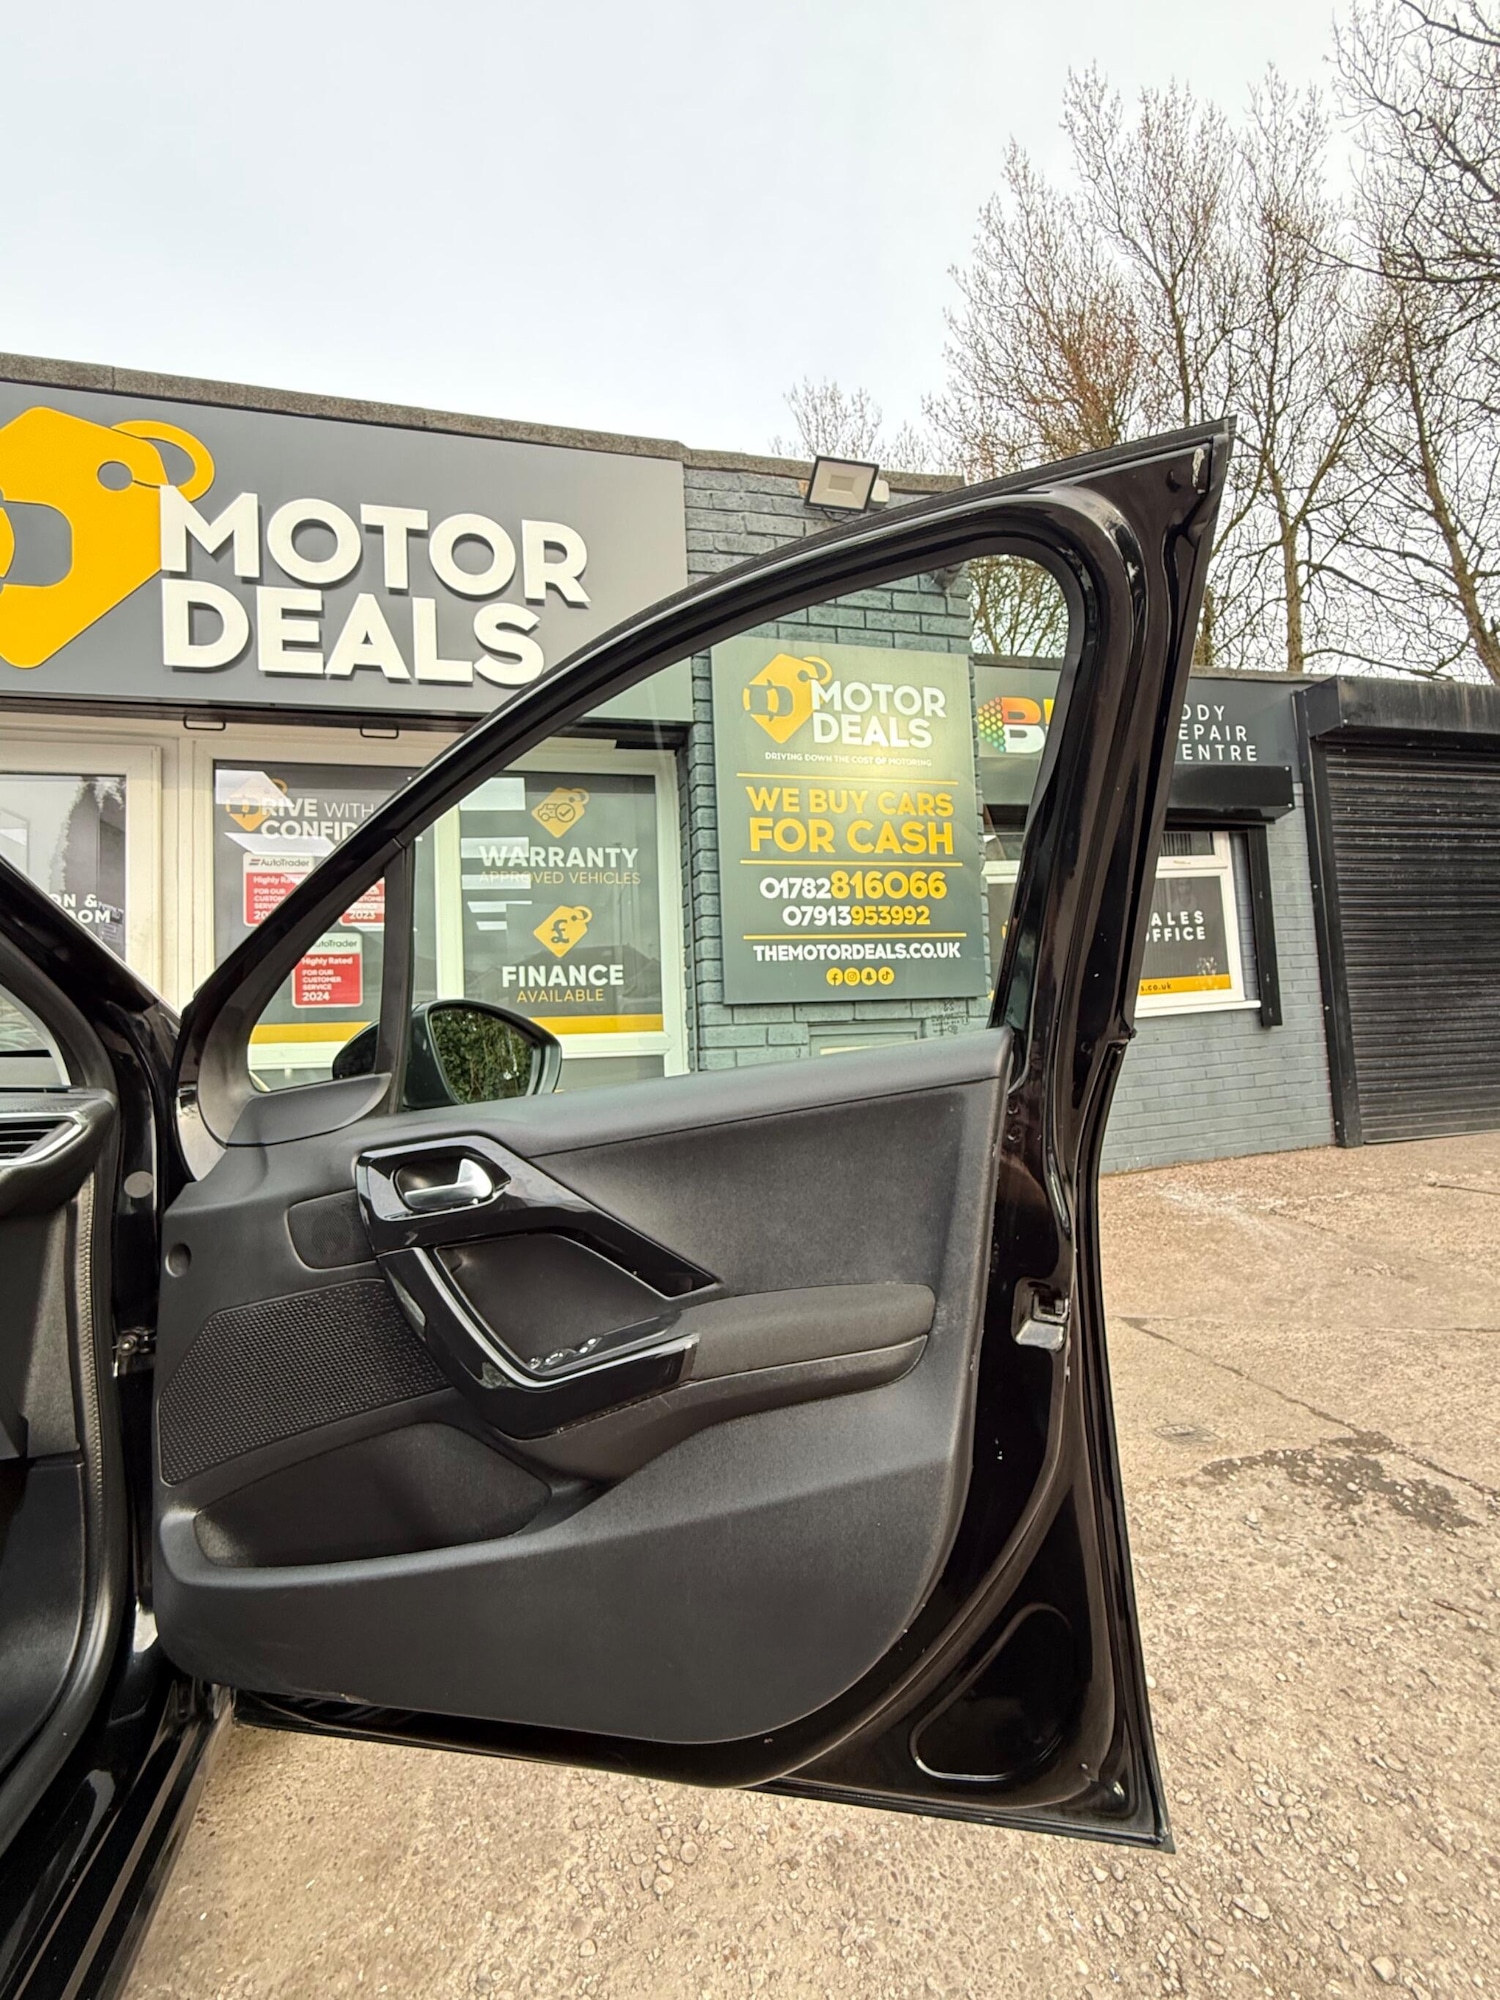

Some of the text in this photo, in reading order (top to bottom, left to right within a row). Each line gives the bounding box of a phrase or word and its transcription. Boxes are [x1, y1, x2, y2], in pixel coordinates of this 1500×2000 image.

[160, 485, 591, 605] MOTOR
[160, 578, 545, 685] DEALS
[810, 679, 947, 718] MOTOR
[812, 712, 933, 748] DEALS
[765, 751, 933, 767] DRIVING DOWN THE COST OF MOTORING
[746, 786, 954, 817] WE BUY CARS
[750, 817, 954, 855] FOR CASH
[479, 846, 639, 869] WARRANTY
[480, 871, 641, 885] APPROVED VEHICLES
[759, 870, 947, 899] 01782816066
[782, 905, 931, 926] 07913953992
[1145, 926, 1206, 943] FFICE
[328, 956, 354, 965] Rated
[753, 942, 961, 962] THEMOTORDEALS.CO.UK
[302, 976, 342, 984] CUSTOMER
[502, 964, 625, 988] FINANCE
[302, 992, 330, 1002] 2024
[516, 988, 604, 1004] AVAILABLE
